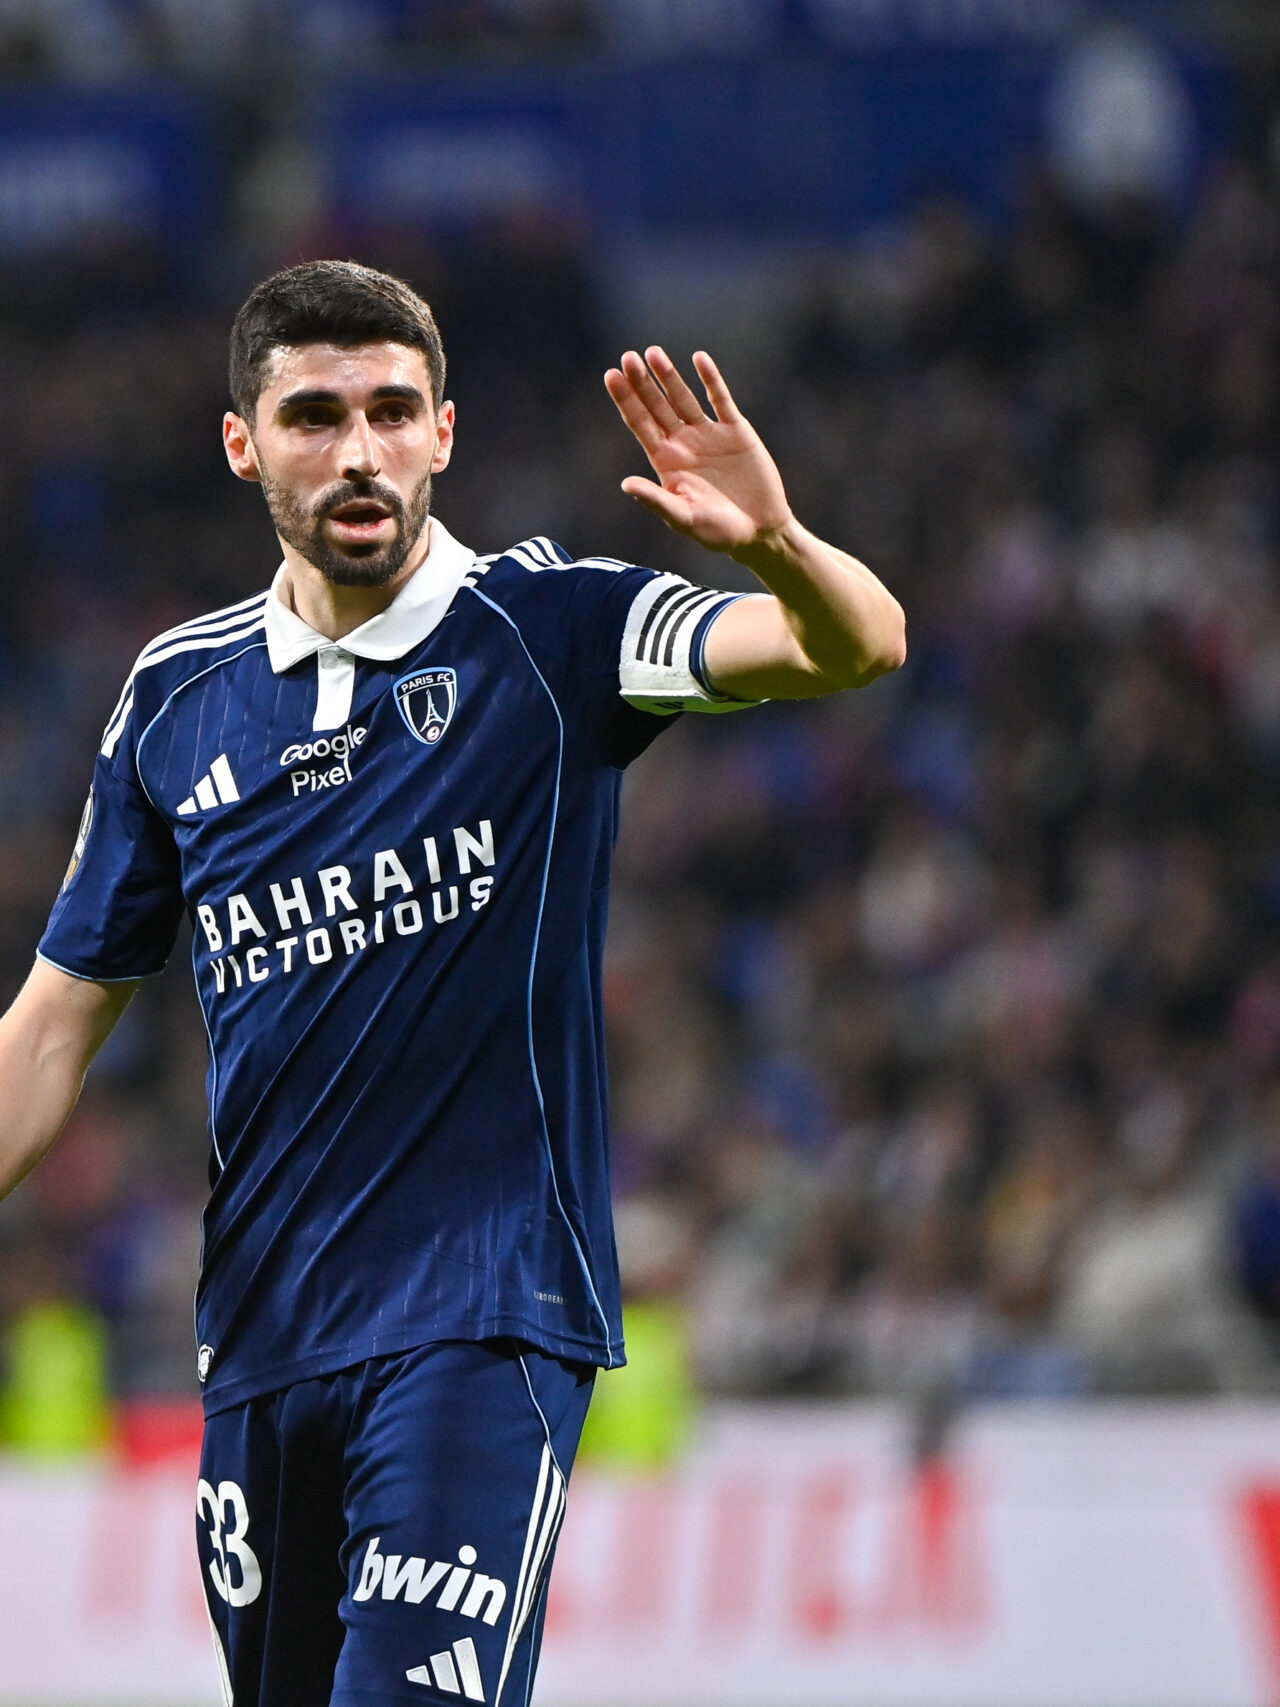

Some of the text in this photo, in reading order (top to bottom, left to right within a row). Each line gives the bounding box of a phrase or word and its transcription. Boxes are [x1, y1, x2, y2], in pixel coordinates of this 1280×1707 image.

[400, 672, 451, 693] PARIS FC
[279, 724, 368, 767] Google
[290, 756, 353, 797] Pixel
[197, 819, 496, 952] BAHRAIN
[209, 875, 495, 994] VICTORIOUS
[196, 1478, 263, 1608] 33
[352, 1536, 508, 1627] bwin
